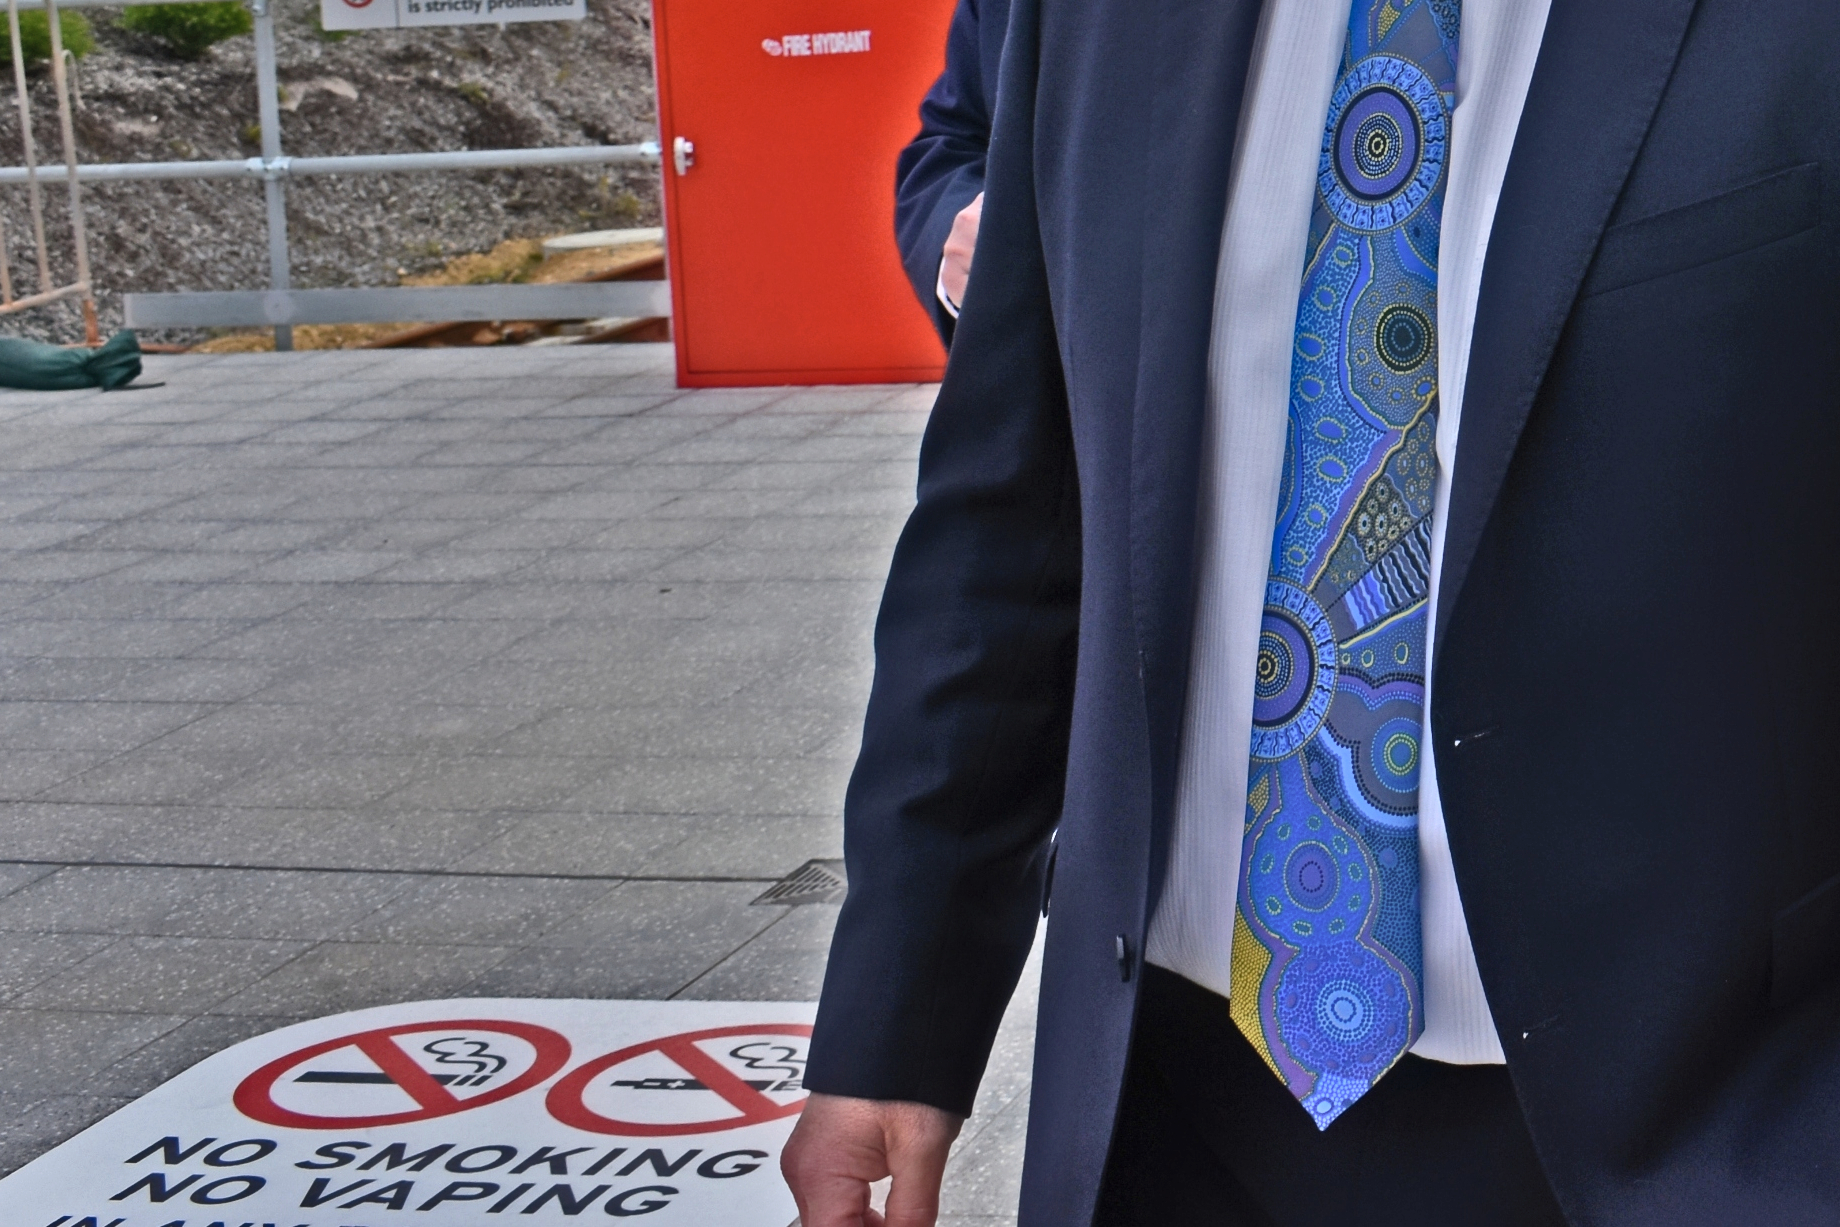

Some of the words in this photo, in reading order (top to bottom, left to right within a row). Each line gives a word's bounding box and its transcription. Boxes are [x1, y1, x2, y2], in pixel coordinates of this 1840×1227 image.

[782, 34, 812, 57] FIRE
[812, 30, 871, 55] HYDRANT
[123, 1136, 278, 1167] NO
[294, 1141, 769, 1179] SMOKING
[108, 1172, 267, 1205] NO
[298, 1177, 680, 1217] VAPING
